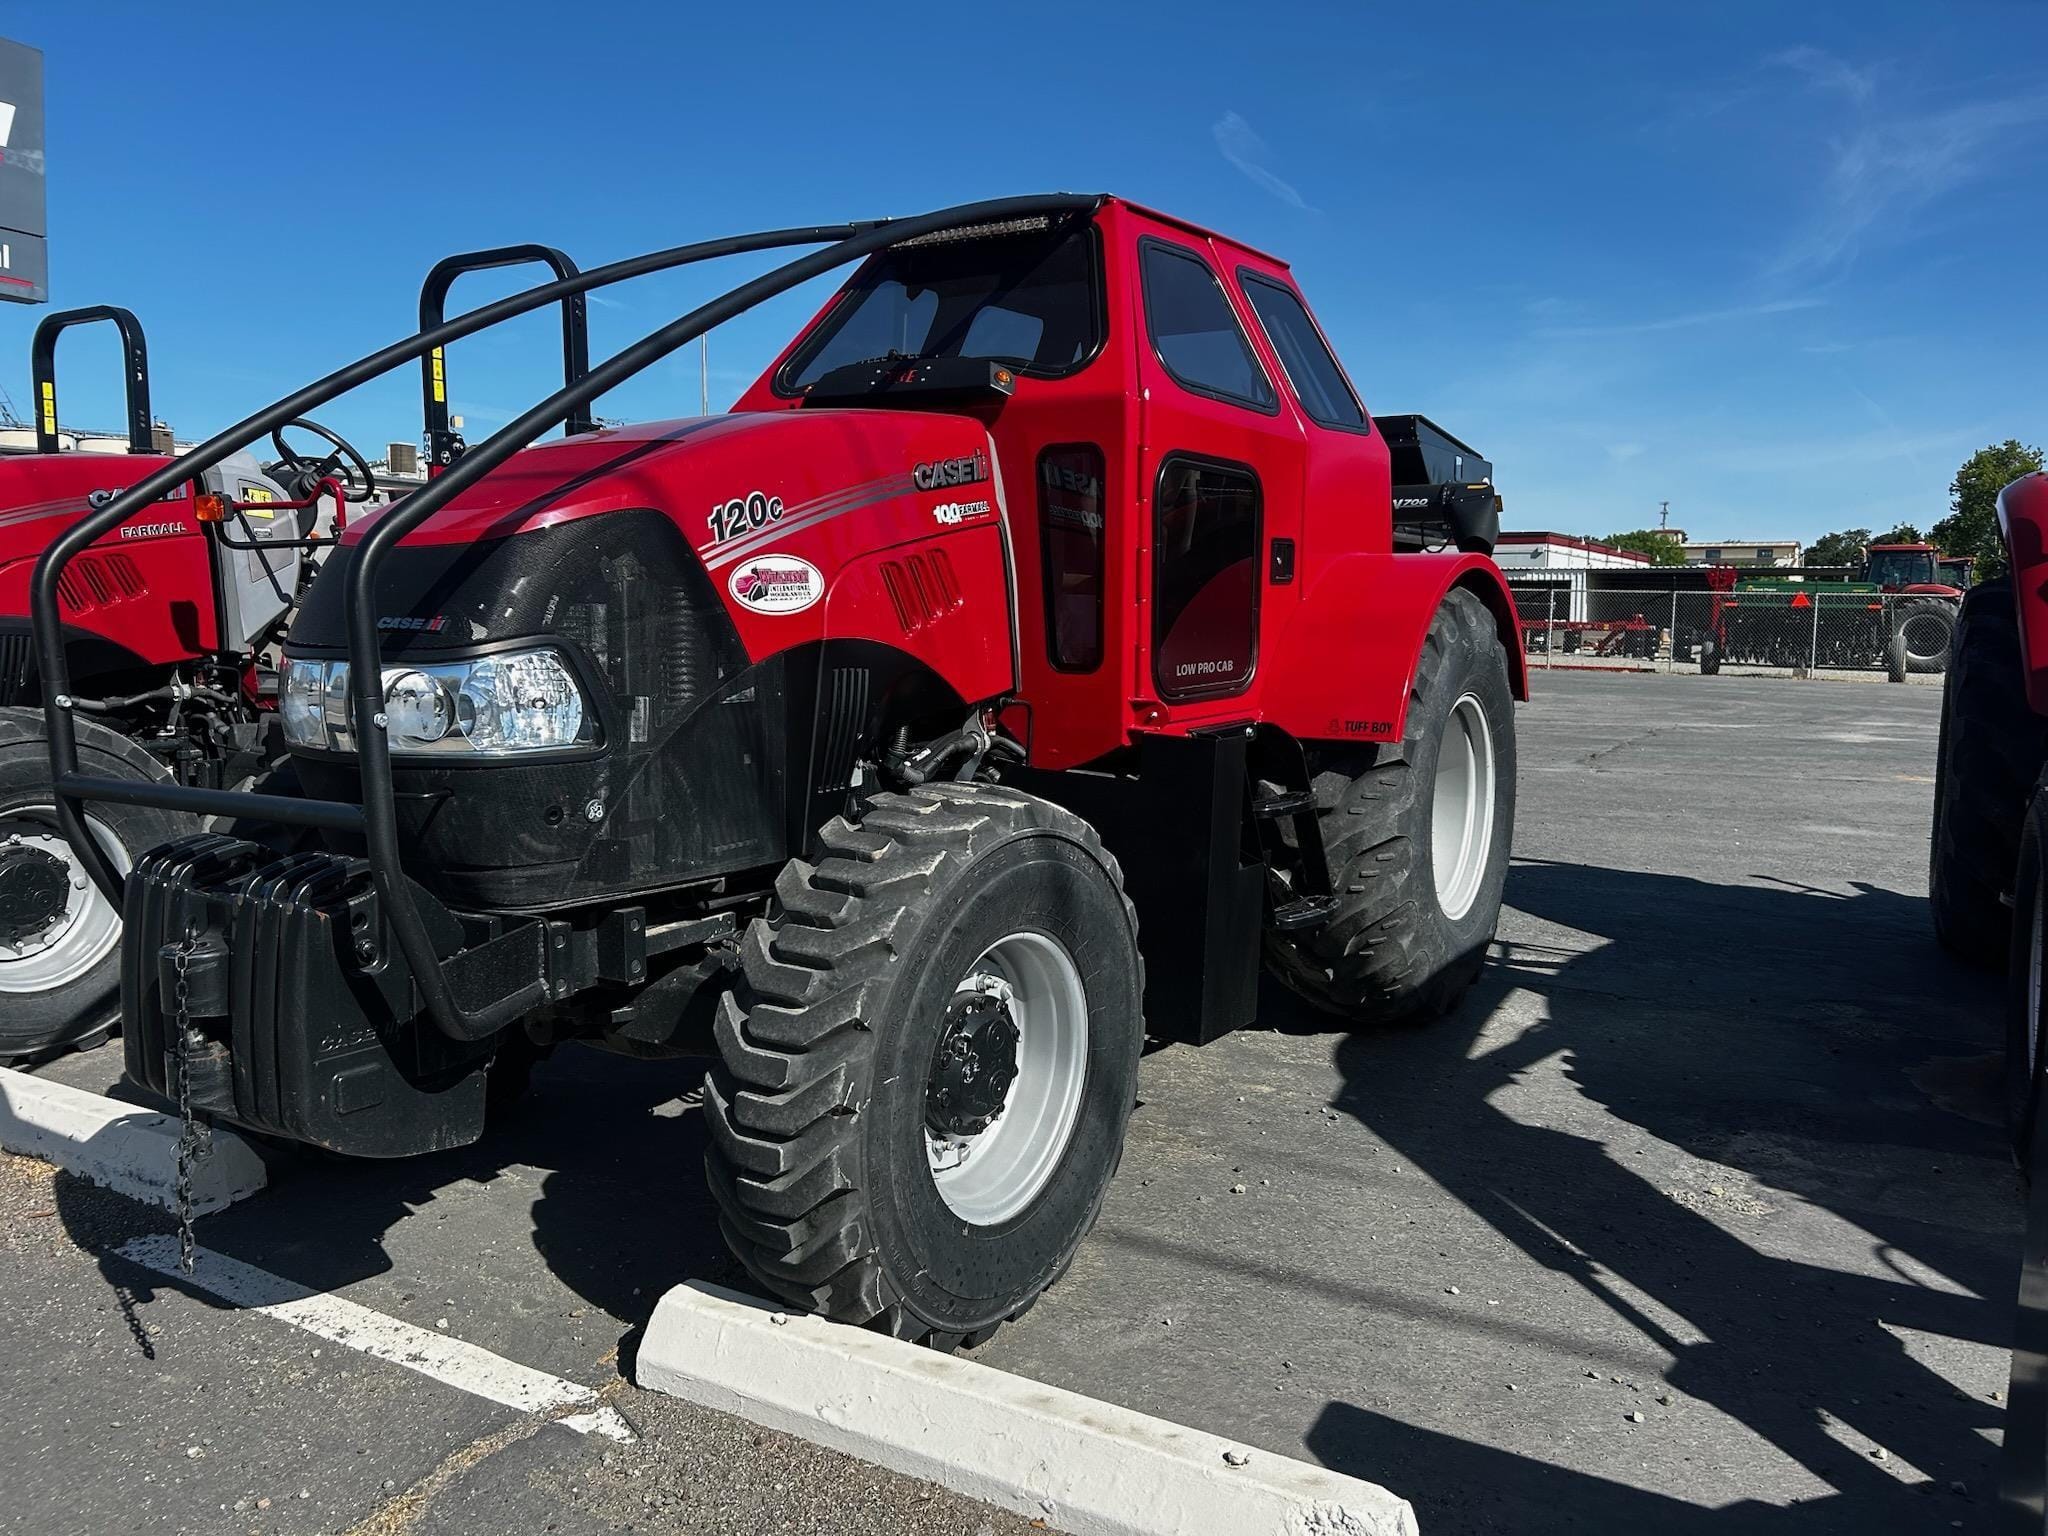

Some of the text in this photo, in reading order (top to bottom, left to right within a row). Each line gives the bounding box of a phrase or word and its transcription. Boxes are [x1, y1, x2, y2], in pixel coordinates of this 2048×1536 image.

[121, 522, 187, 538] FARMALL
[377, 616, 425, 630] CASE
[1176, 659, 1234, 677] LOW PRO CAB
[1344, 720, 1392, 733] TUFF BOY
